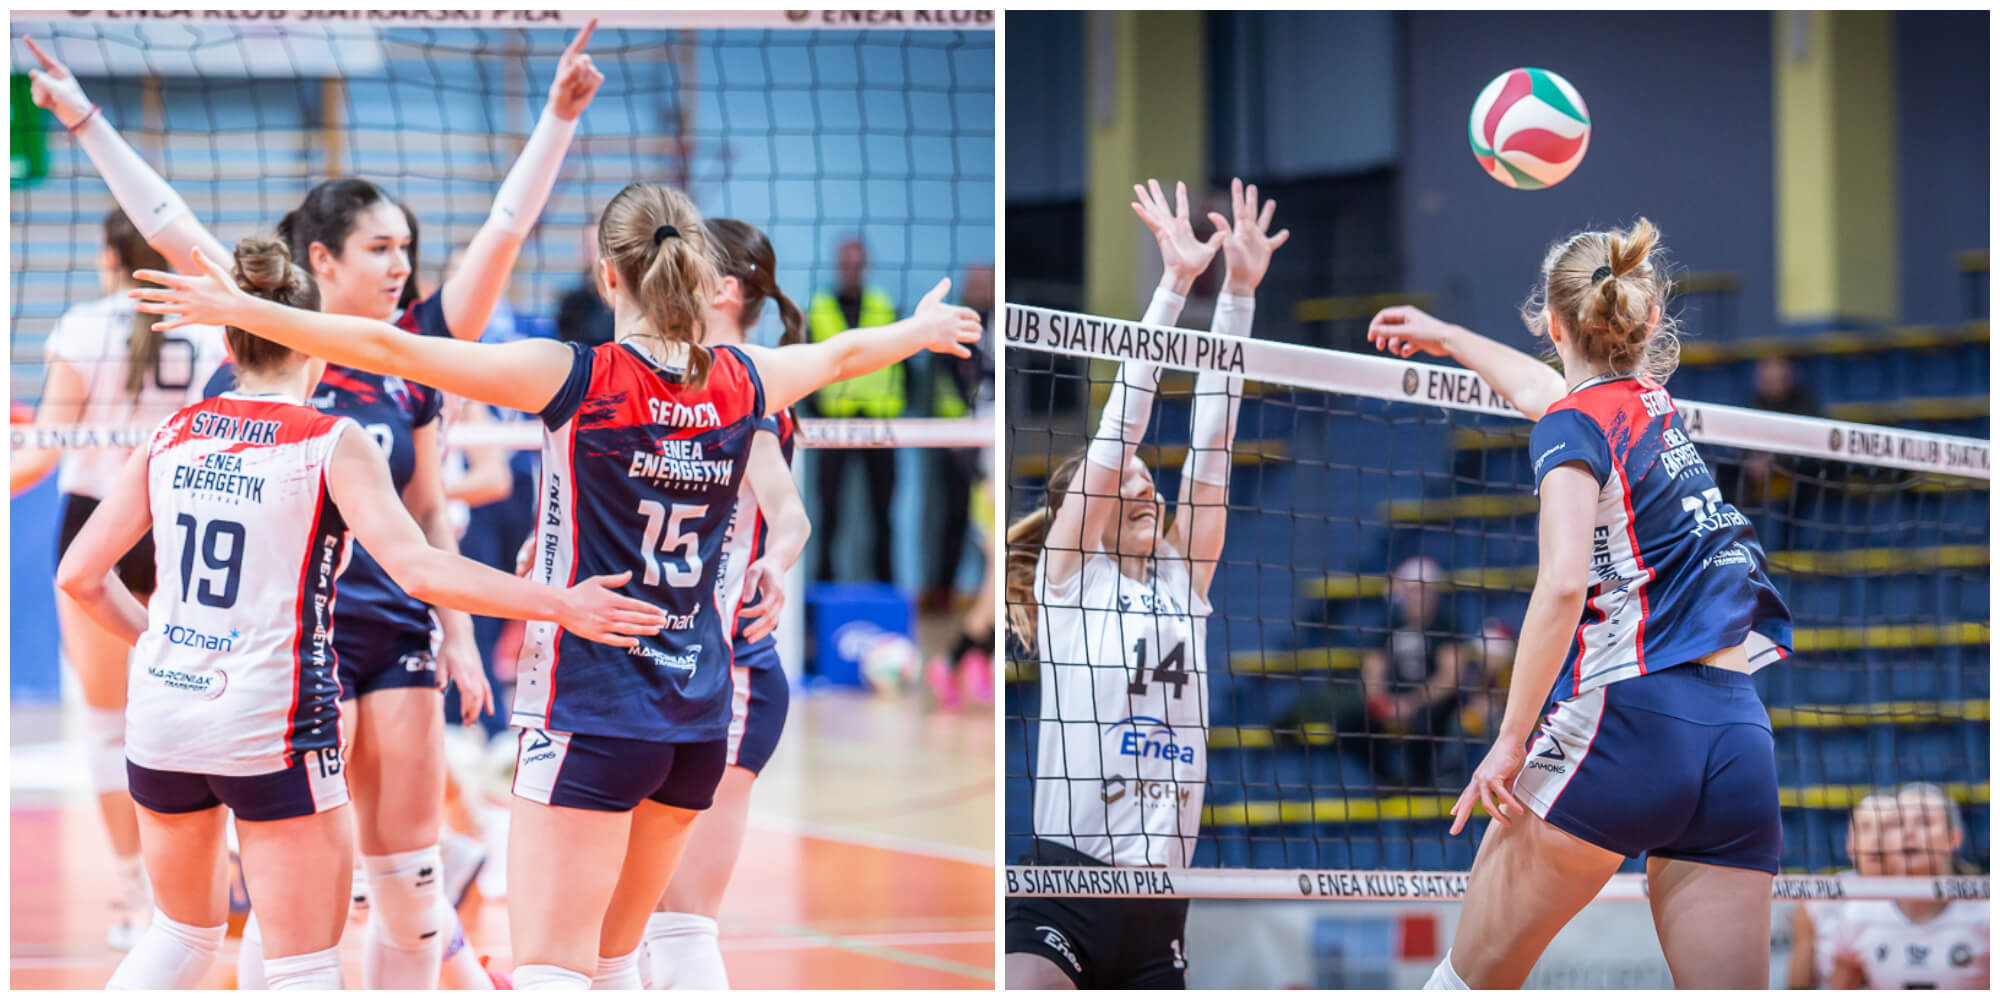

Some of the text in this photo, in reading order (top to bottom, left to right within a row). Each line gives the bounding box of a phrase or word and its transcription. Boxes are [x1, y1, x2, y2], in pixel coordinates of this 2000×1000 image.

[1005, 307, 1245, 374] UB SIATKARSKI PIŁA
[1427, 370, 1482, 405] ENEA
[192, 412, 281, 445] STRYJAK
[648, 397, 722, 428] SEMCA
[661, 440, 703, 461] ENEA
[1848, 429, 1895, 457] ENEA
[204, 453, 243, 473] ENEA
[628, 450, 734, 486] ENERGETYK
[173, 465, 265, 504] ENERGETYK
[175, 512, 247, 609] 19
[637, 500, 710, 588] 15
[1127, 637, 1189, 699] 14
[316, 747, 342, 779] 19
[1120, 731, 1195, 765] Enea
[1023, 869, 1130, 895] SIATKARSKI
[1134, 870, 1176, 895] PIŁA
[1317, 873, 1470, 897] ENEA KLUB SIATKA
[1043, 931, 1083, 973] Enea
